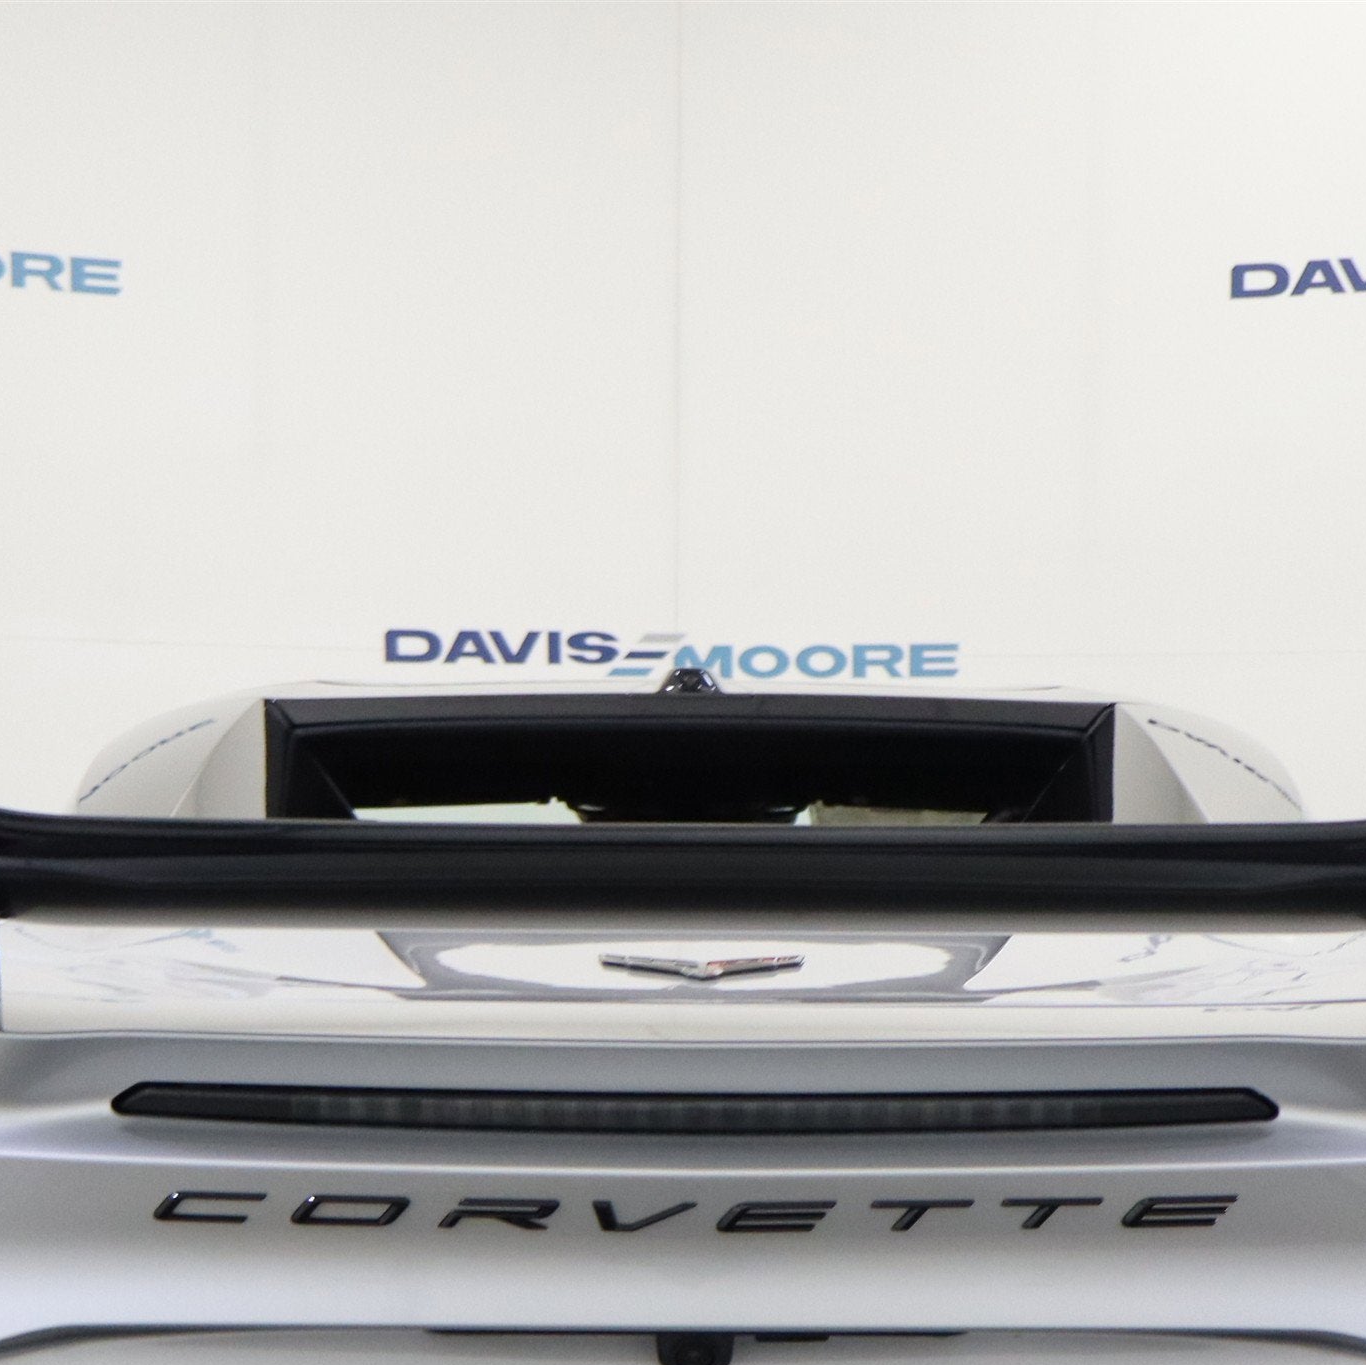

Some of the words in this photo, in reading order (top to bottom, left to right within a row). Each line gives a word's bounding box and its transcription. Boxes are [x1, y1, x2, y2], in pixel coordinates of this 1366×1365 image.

[385, 628, 619, 665] DAVIS
[673, 643, 960, 679] MOORE
[152, 1189, 1239, 1234] CORVETTE
